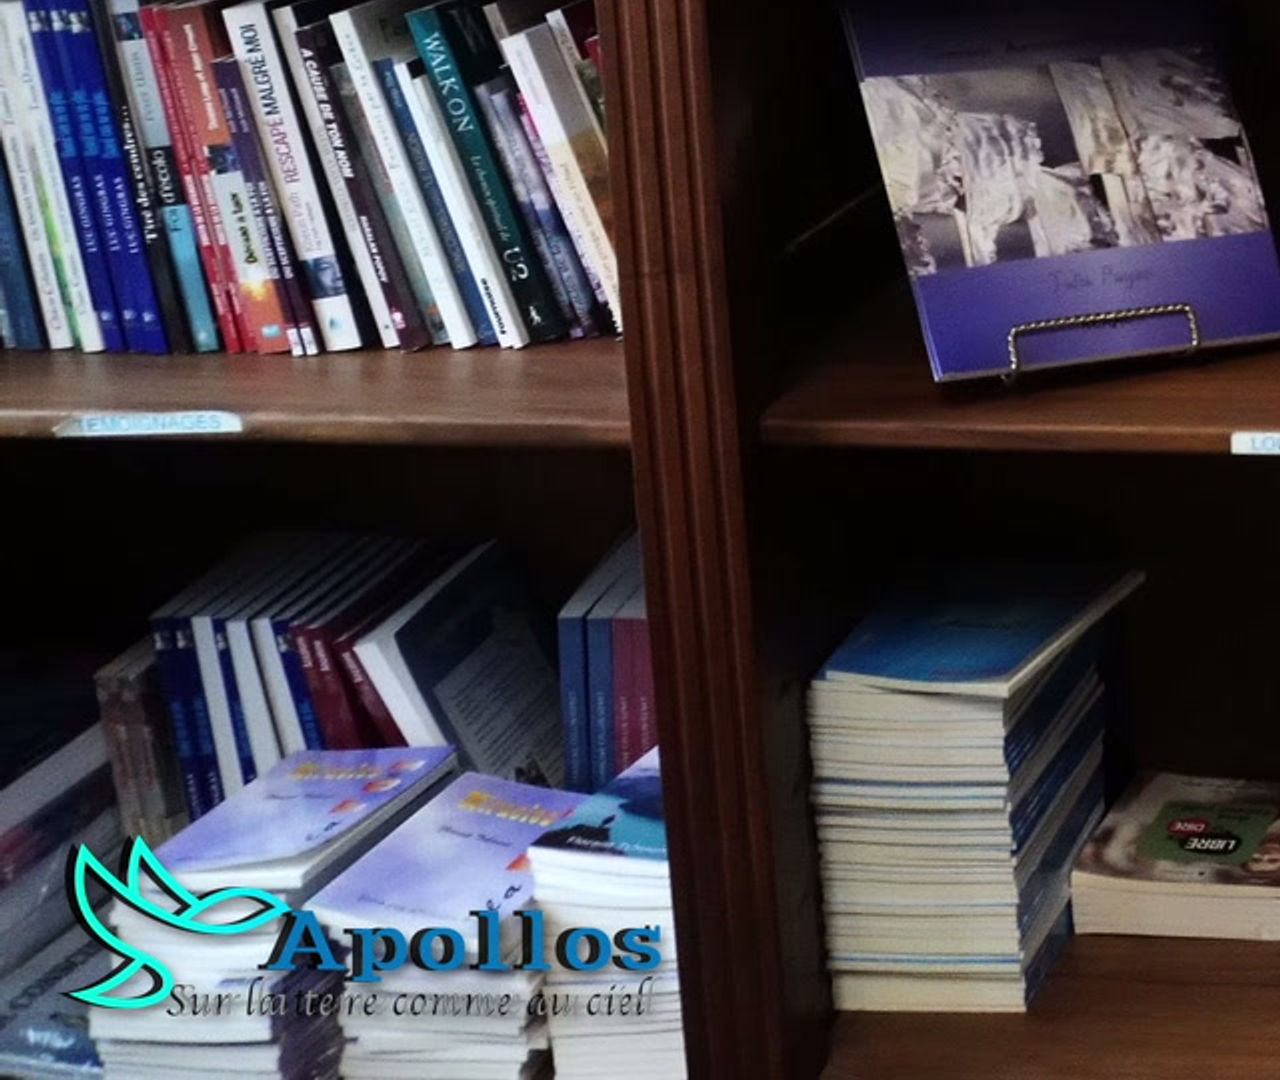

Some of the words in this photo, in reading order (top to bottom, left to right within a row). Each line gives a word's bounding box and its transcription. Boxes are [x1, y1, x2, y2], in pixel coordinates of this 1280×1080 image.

[238, 22, 262, 54] MOI
[251, 56, 281, 116] MALGRÉ
[304, 60, 331, 102] CAUSE
[420, 30, 459, 93] WALK
[445, 96, 474, 133] ON
[317, 103, 336, 121] DE
[119, 104, 146, 180] cendres...
[267, 116, 300, 185] RESCAPÉ
[323, 122, 344, 150] TON
[150, 149, 176, 204] d'écolo
[333, 150, 355, 179] NOM
[93, 173, 114, 227] GINGRAS
[134, 180, 150, 207] des
[104, 228, 121, 252] LUC
[138, 208, 159, 246] Tiré
[1183, 836, 1238, 853] LIBRE
